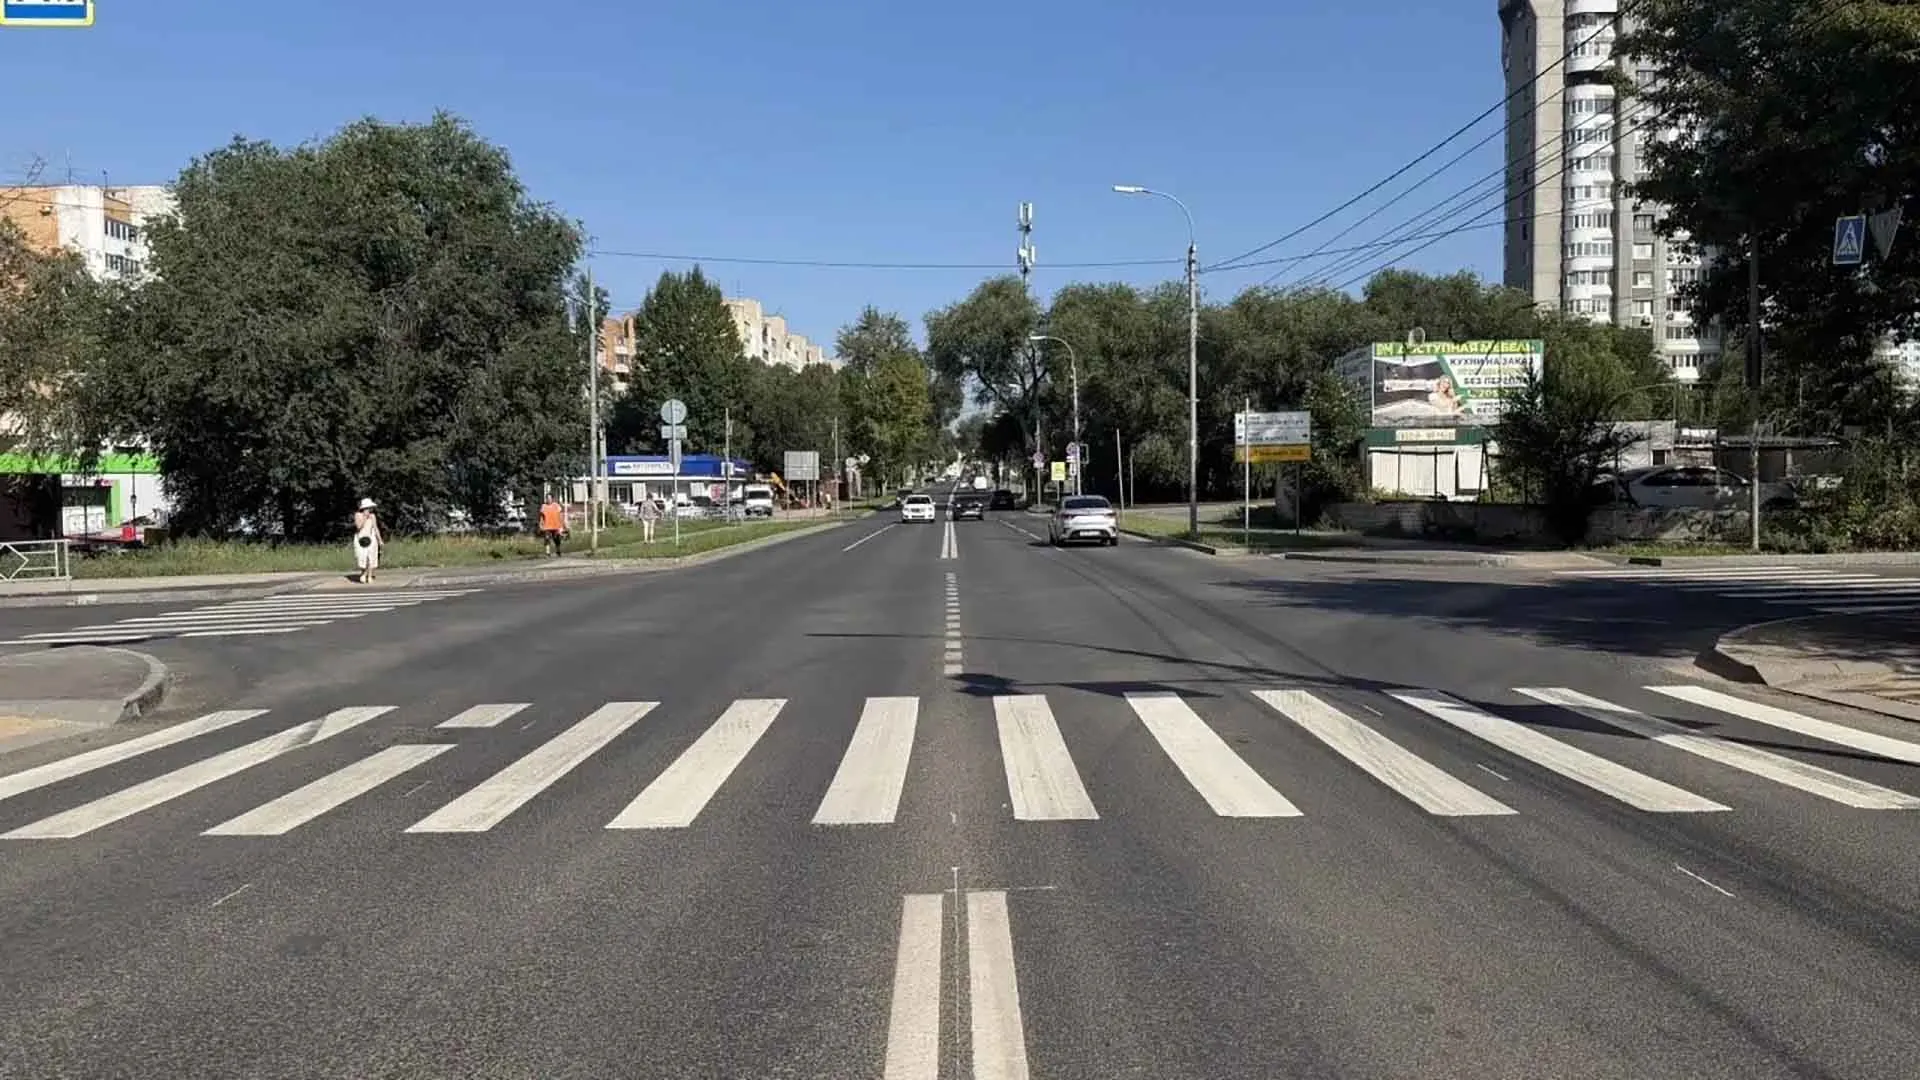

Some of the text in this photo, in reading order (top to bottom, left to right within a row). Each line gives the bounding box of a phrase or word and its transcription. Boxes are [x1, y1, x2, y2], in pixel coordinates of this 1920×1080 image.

[1450, 357, 1484, 366] КУХНИ
[1485, 357, 1500, 365] НА
[1464, 377, 1482, 385] БЕЗ
